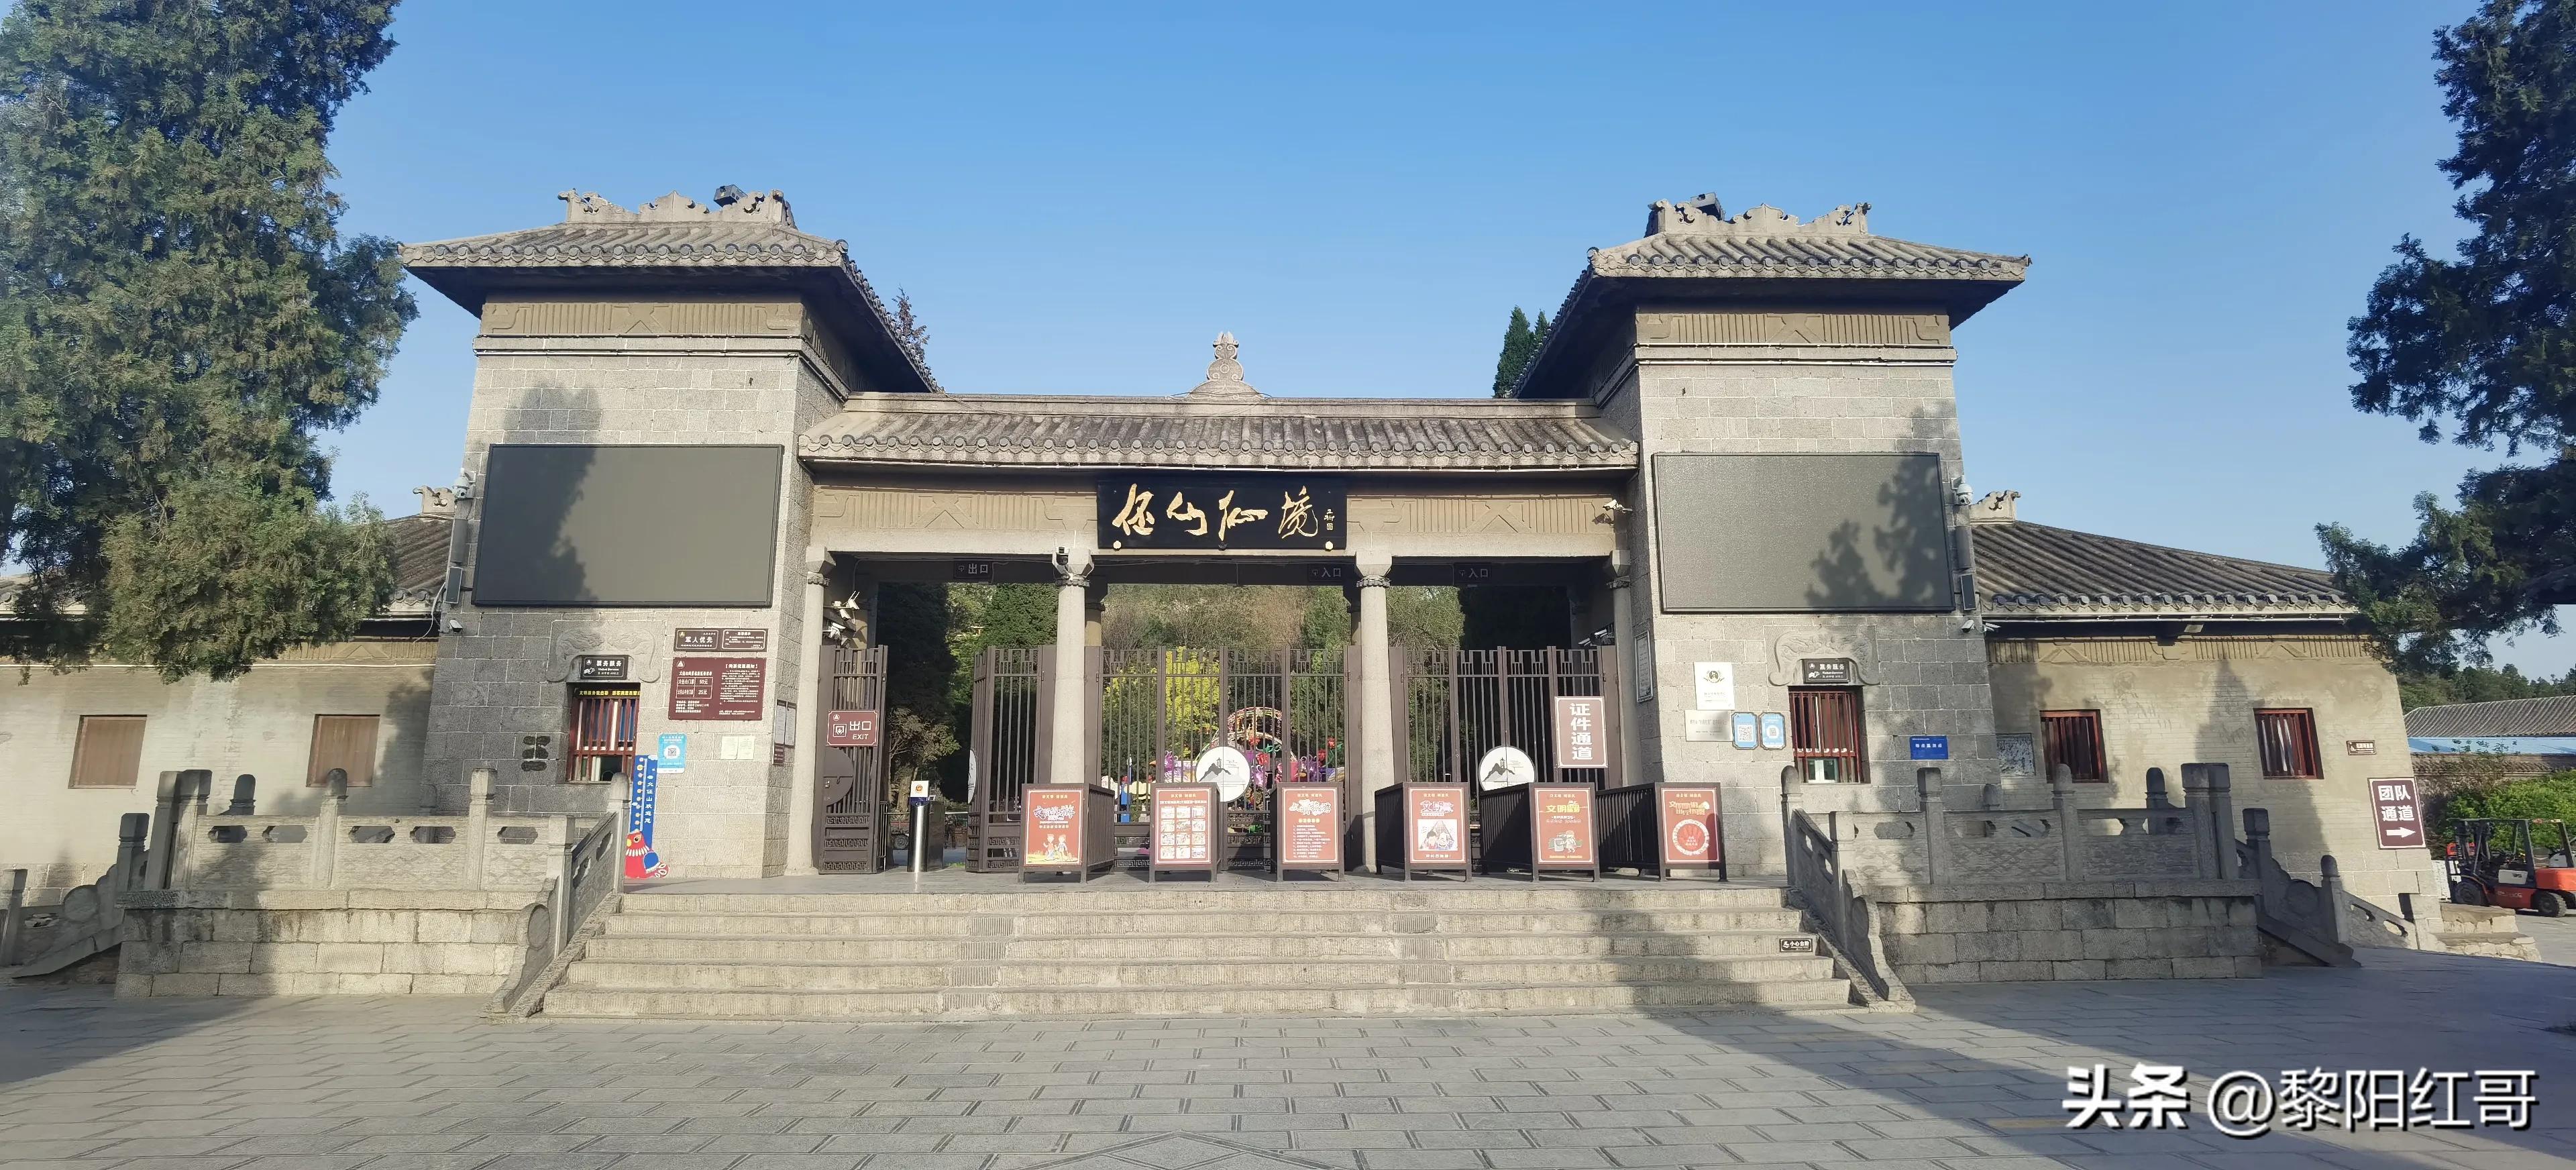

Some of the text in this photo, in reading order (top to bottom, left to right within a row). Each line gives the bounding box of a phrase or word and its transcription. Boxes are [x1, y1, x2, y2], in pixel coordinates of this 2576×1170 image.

[968, 564, 988, 574] 出口
[1321, 567, 1342, 578] 入口
[1468, 568, 1489, 578] 入口
[849, 721, 871, 731] 出口
[1570, 703, 1593, 760] 证件通道
[2377, 784, 2411, 801] 团队
[2380, 804, 2415, 822] 通道
